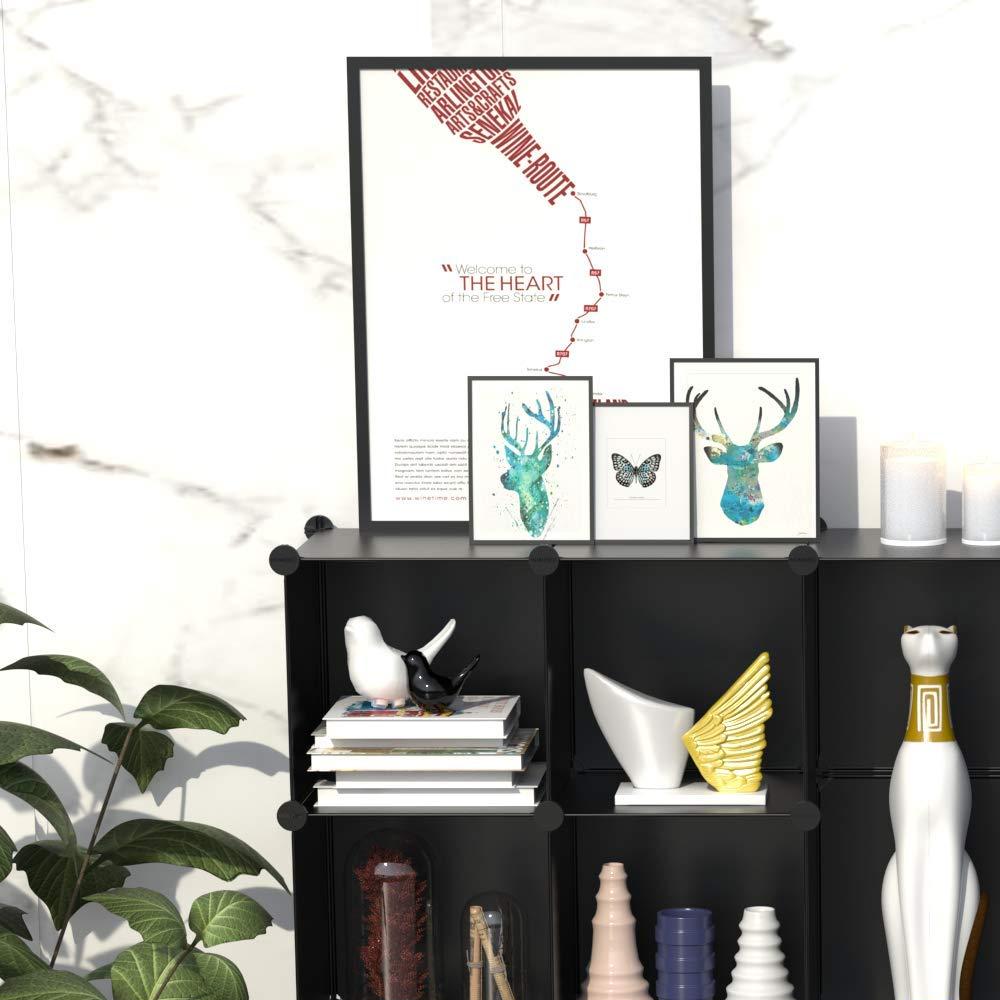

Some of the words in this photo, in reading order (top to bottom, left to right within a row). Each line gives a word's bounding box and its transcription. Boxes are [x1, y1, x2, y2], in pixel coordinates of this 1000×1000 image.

[445, 71, 517, 135] ARTS&CRAFTS
[459, 89, 521, 144] SENEKAL
[490, 118, 576, 206] WINE-ROUTE
[456, 264, 517, 275] Welcome
[520, 264, 533, 275] to
[459, 276, 495, 290] THE
[500, 276, 563, 290] HEART
[442, 292, 455, 302] of
[458, 292, 479, 302] the
[483, 292, 510, 302] Free
[512, 292, 545, 302] State
